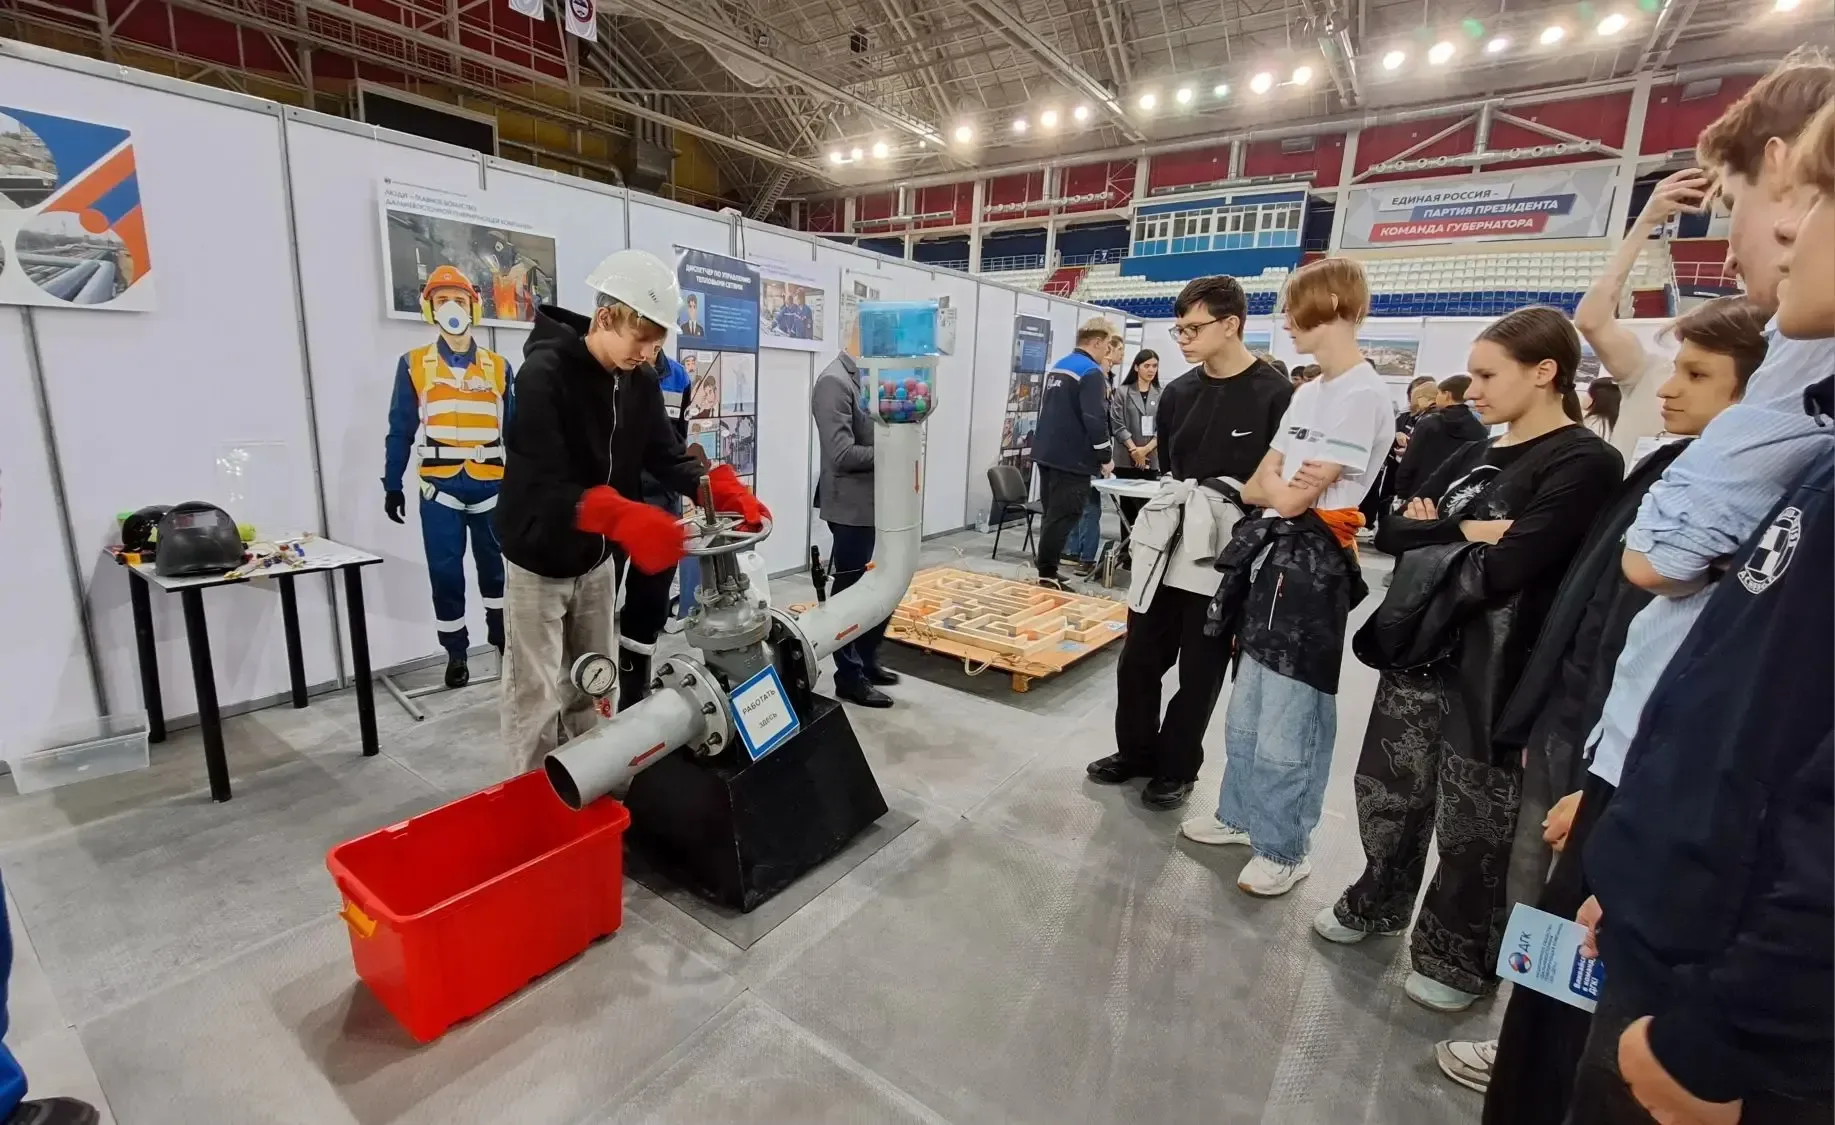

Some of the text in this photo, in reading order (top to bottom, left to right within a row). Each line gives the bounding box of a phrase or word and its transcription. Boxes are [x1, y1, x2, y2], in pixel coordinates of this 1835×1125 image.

[1391, 193, 1441, 206] ЕДИНАЯ
[1442, 189, 1491, 202] РОССИЯ
[1424, 199, 1559, 219] ПАРТИЯ ПРЕЗИДЕНТА
[1380, 218, 1533, 237] КОМАНДА ГУБЕРНАТОРА
[685, 264, 713, 277] ДИСПЕТЧЕР
[714, 269, 722, 278] ПО
[742, 689, 776, 715] РАБОТАТЬ
[759, 713, 777, 728] ЗДЕСЬ
[1518, 930, 1532, 953] ДГК
[1573, 956, 1586, 989] Вливайс
